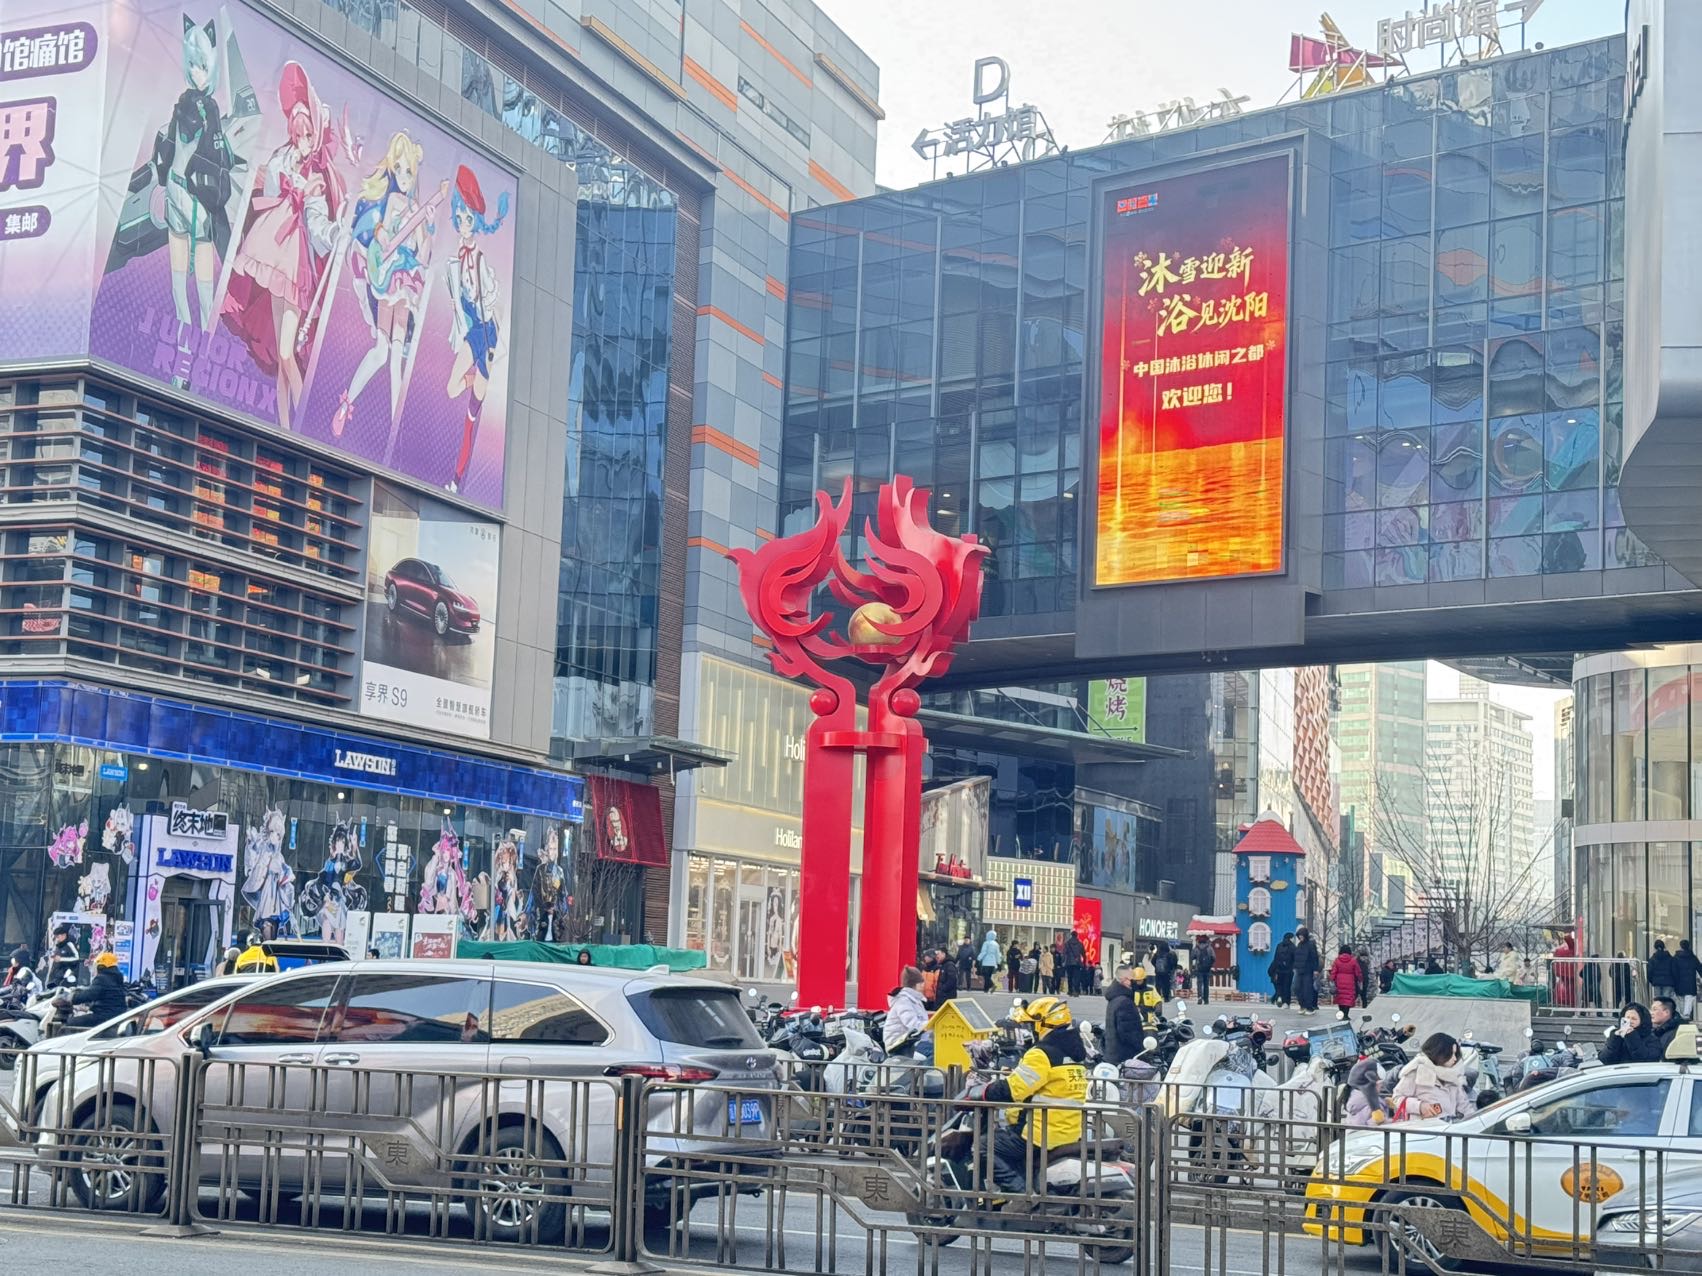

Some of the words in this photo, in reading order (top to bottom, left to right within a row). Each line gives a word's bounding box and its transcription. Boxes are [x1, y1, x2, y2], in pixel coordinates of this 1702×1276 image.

[1377, 0, 1499, 56] 时尚馆
[0, 29, 85, 72] 馆痛馆
[973, 56, 1011, 105] D
[943, 103, 1038, 157] 活力馆
[4, 212, 39, 235] 集邮
[1138, 246, 1254, 297] 沐雪迎新
[1157, 291, 1269, 338] 浴见沈阳
[1133, 344, 1264, 378] 中国沐浴休闲之都
[1161, 382, 1234, 410] 欢迎您！
[364, 681, 388, 704] 享界
[391, 687, 408, 708] S9
[1105, 678, 1128, 721] 烧烤
[334, 749, 392, 775] LAWSON
[784, 735, 806, 761] Holi
[156, 848, 234, 873] LAWSON
[1139, 918, 1166, 938] HONOR
[385, 1140, 409, 1166] 東
[863, 1173, 890, 1202] 東
[1439, 1217, 1471, 1249] 東
